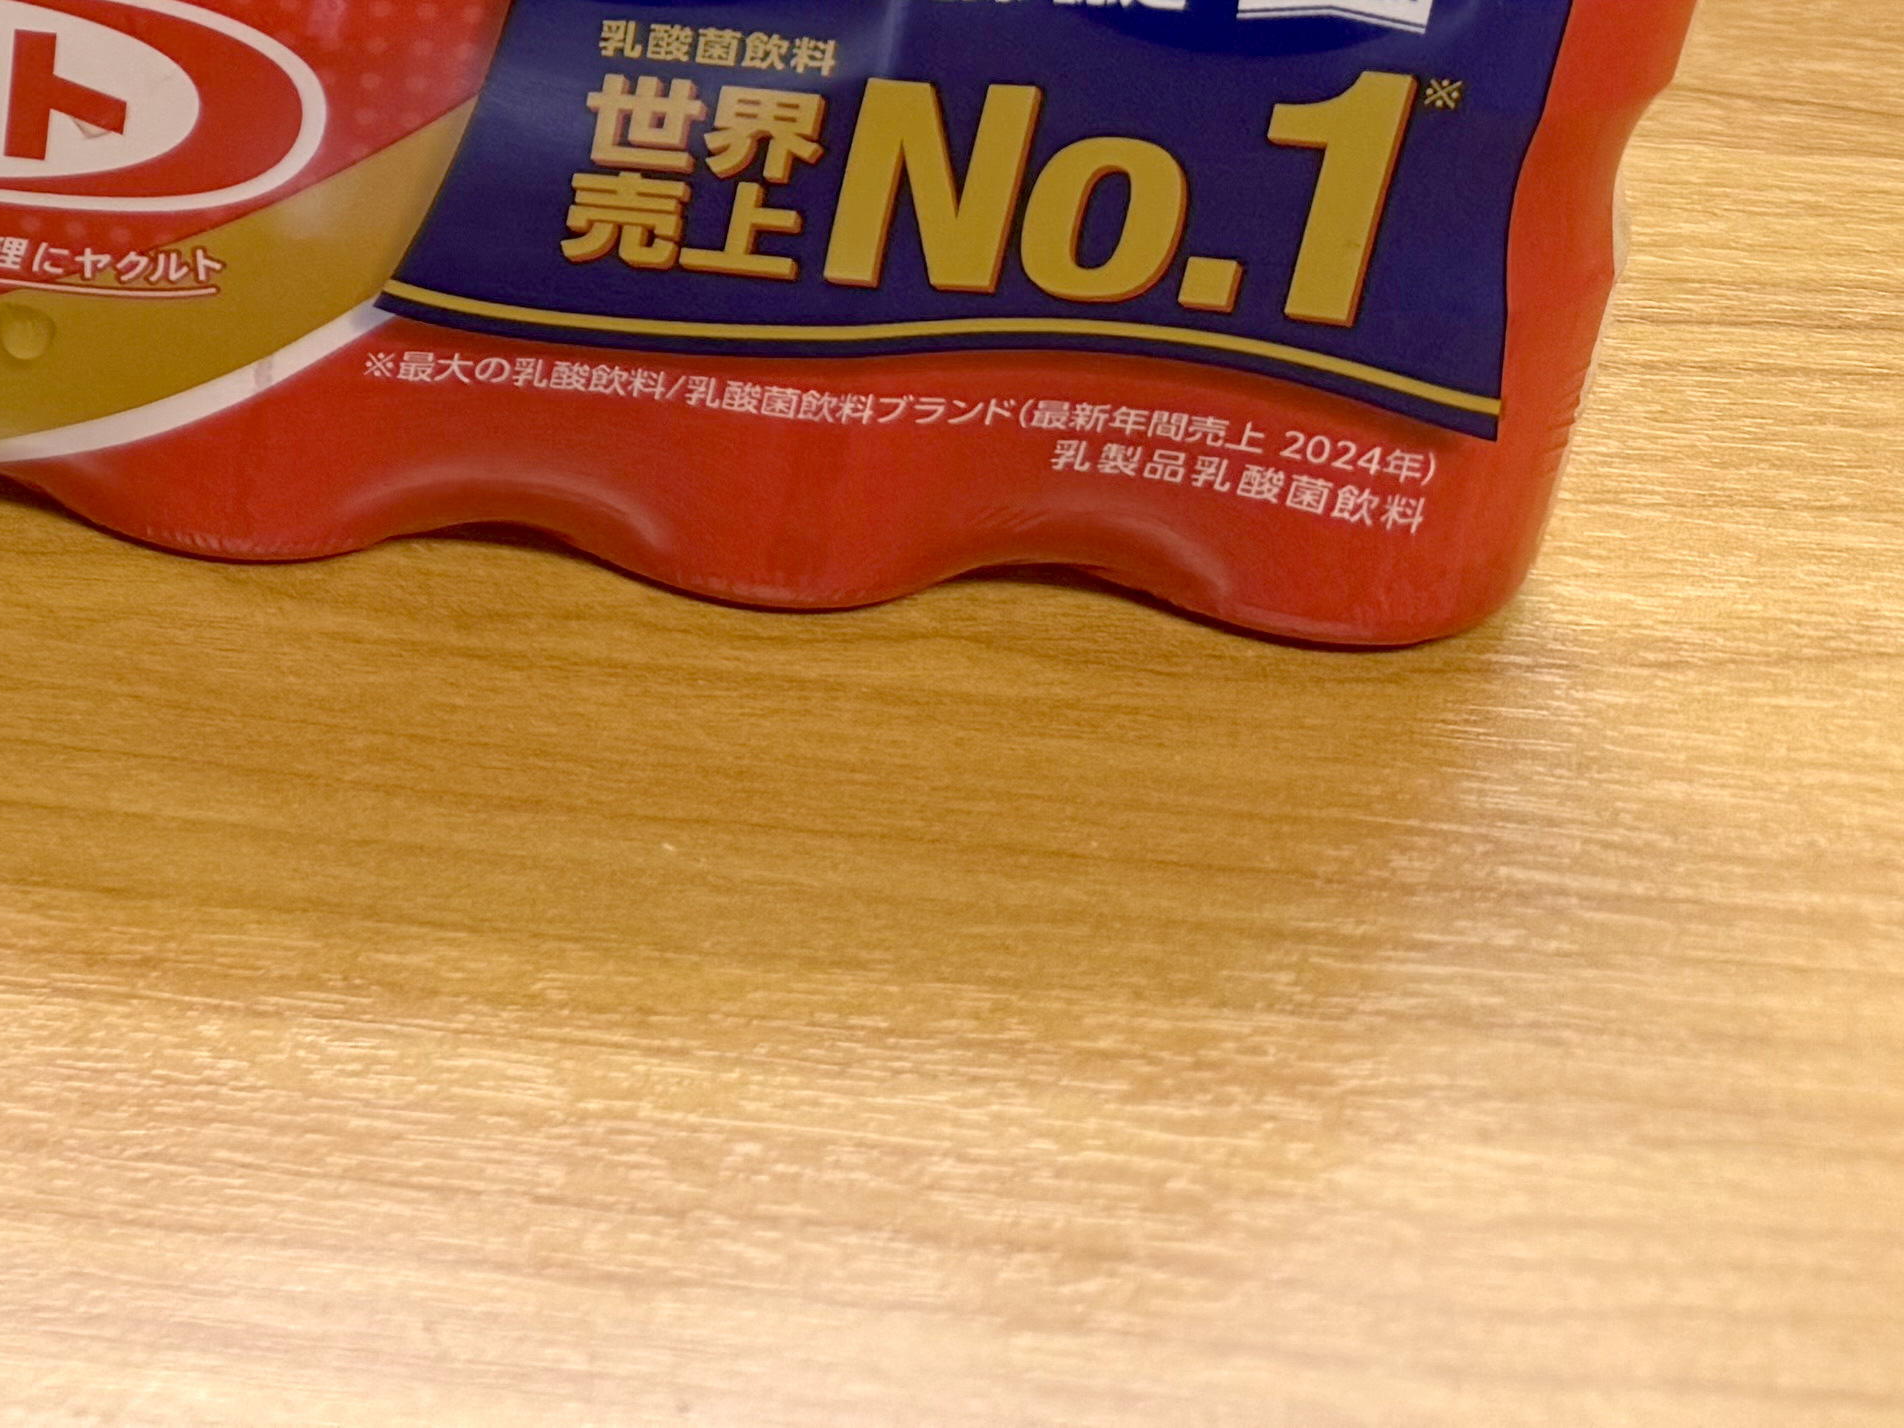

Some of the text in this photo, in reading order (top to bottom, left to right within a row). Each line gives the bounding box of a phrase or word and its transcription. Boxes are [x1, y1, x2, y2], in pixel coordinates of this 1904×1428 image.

[598, 17, 840, 76] 乳酸菌飲料
[585, 72, 828, 185] 世界
[561, 172, 802, 281] 売上
[823, 69, 1419, 329] No.1
[1049, 437, 1427, 536] 乳製品乳酸菌飲料
